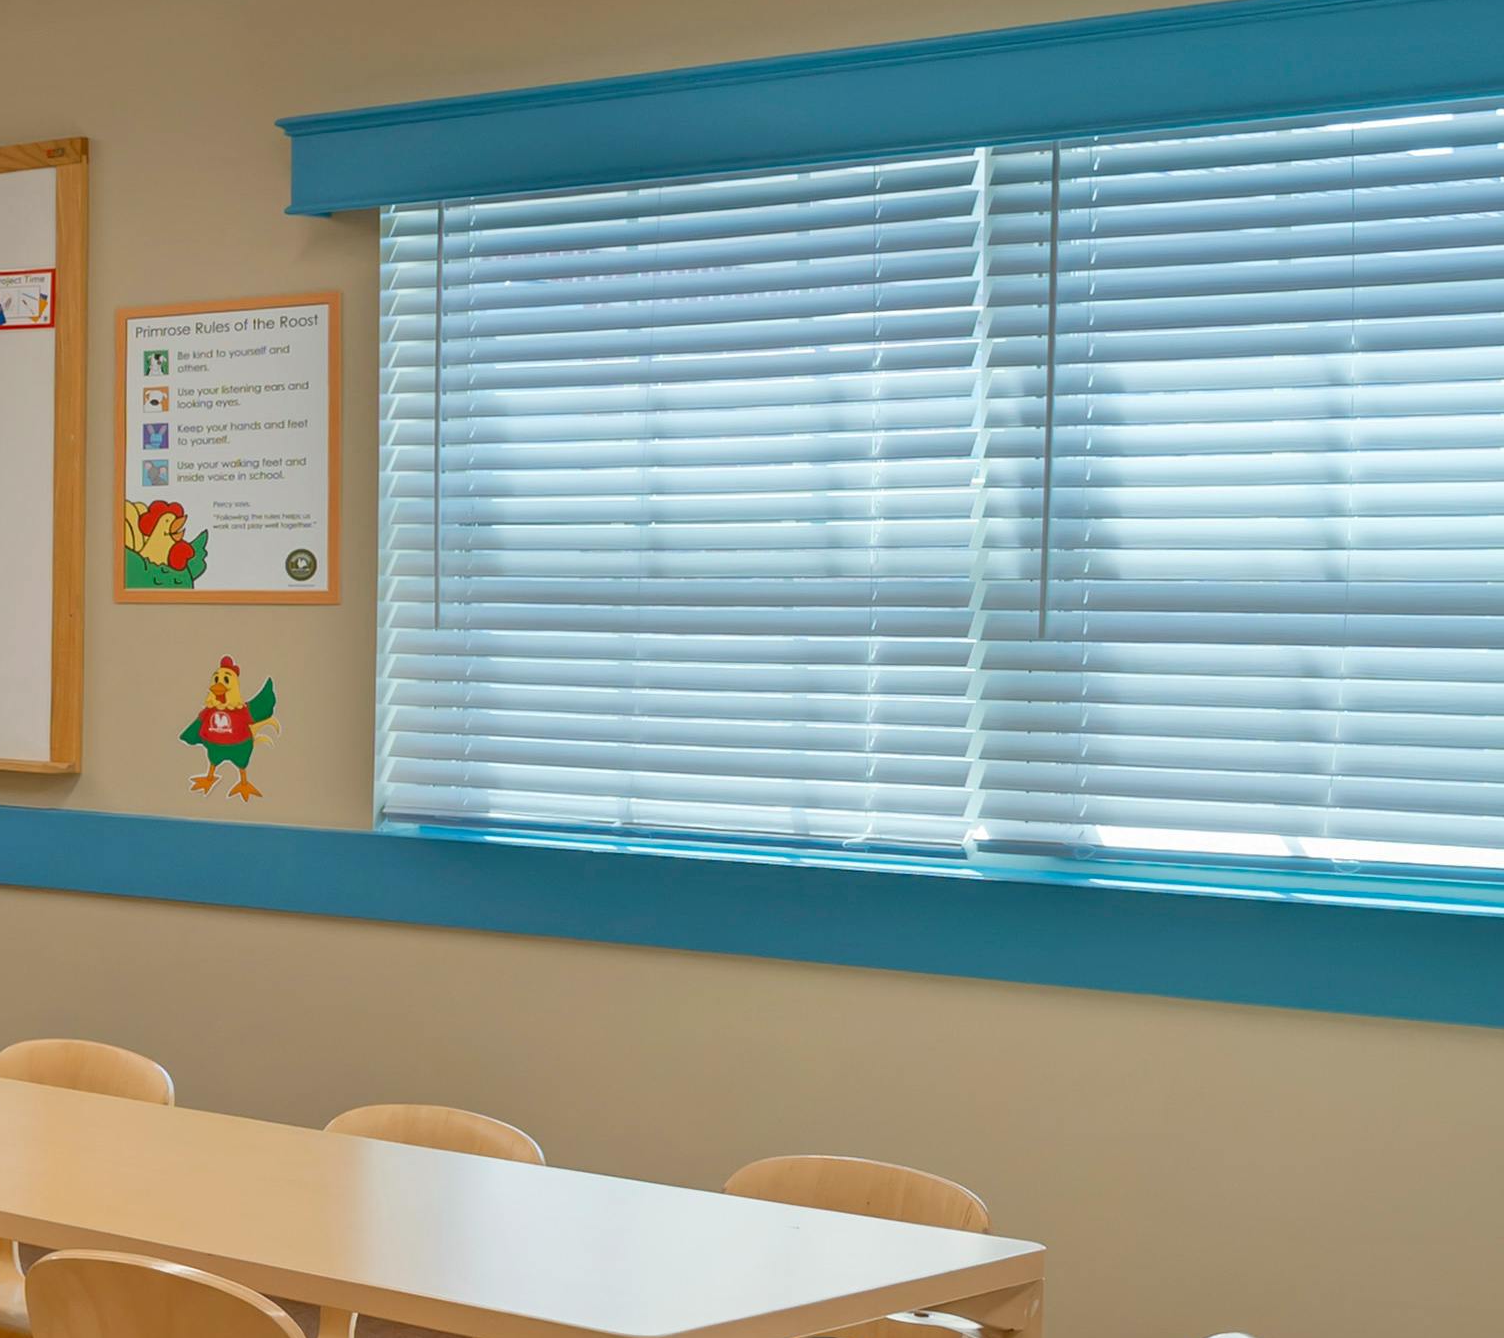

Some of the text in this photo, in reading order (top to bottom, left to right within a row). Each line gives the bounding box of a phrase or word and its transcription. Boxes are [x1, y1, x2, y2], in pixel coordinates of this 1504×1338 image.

[135, 314, 318, 338] Primrose Rules of the Roost
[177, 345, 289, 360] Be kind to yourself and
[178, 388, 195, 396] Use
[197, 387, 219, 396] your
[288, 381, 309, 390] and
[177, 399, 213, 409] looking
[177, 424, 204, 433] Keep
[206, 424, 227, 433] your
[230, 421, 261, 430] hands
[264, 420, 285, 430] and
[178, 437, 188, 445] to
[177, 461, 195, 469] Use
[197, 460, 219, 470] your
[221, 458, 260, 469] walking
[285, 457, 306, 466] and
[177, 473, 205, 482] inside
[207, 472, 235, 481] voice
[237, 472, 246, 480] in
